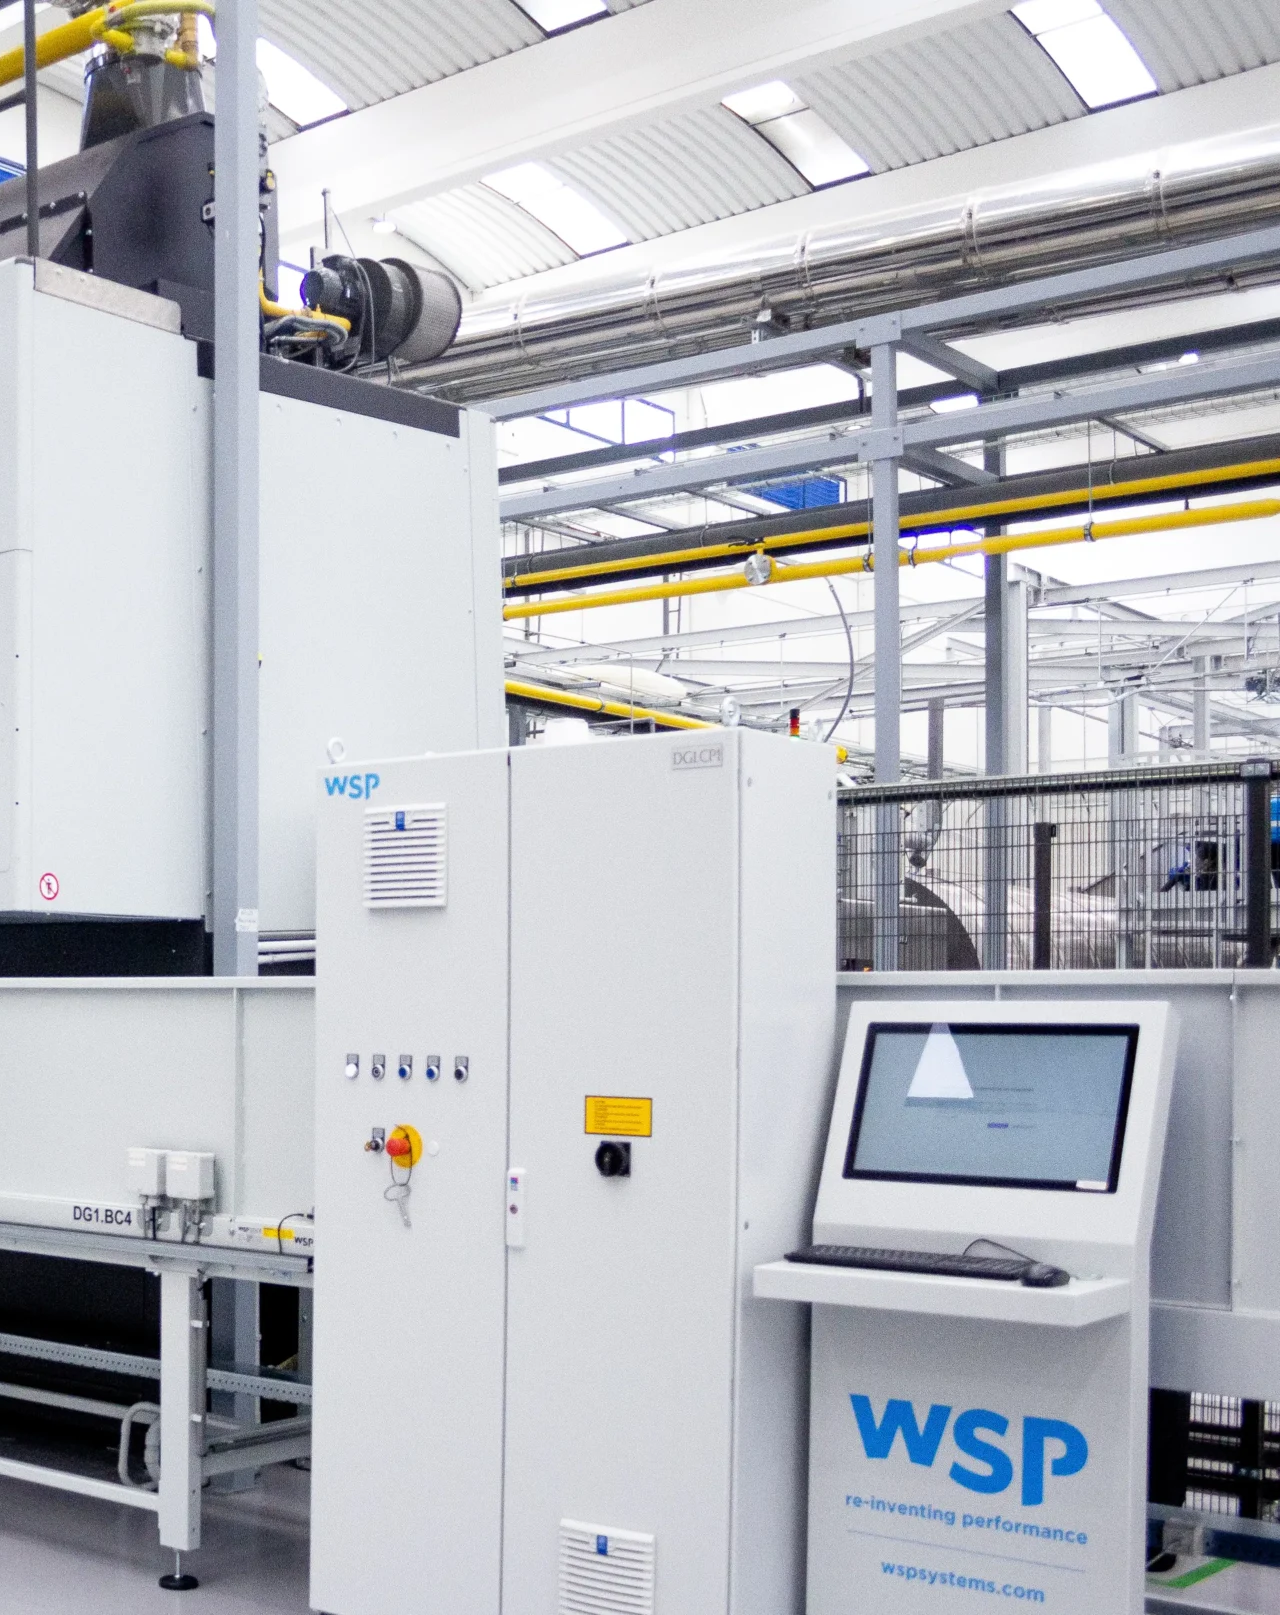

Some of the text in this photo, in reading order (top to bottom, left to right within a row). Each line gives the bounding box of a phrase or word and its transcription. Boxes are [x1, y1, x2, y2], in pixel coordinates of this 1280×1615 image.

[324, 773, 380, 800] WSP
[73, 1205, 132, 1226] DG1.BC4
[294, 1236, 314, 1247] WSP
[849, 1393, 1089, 1506] WSP
[845, 1493, 1088, 1545] re-inventing performance
[881, 1561, 1045, 1603] wspsystems.com
